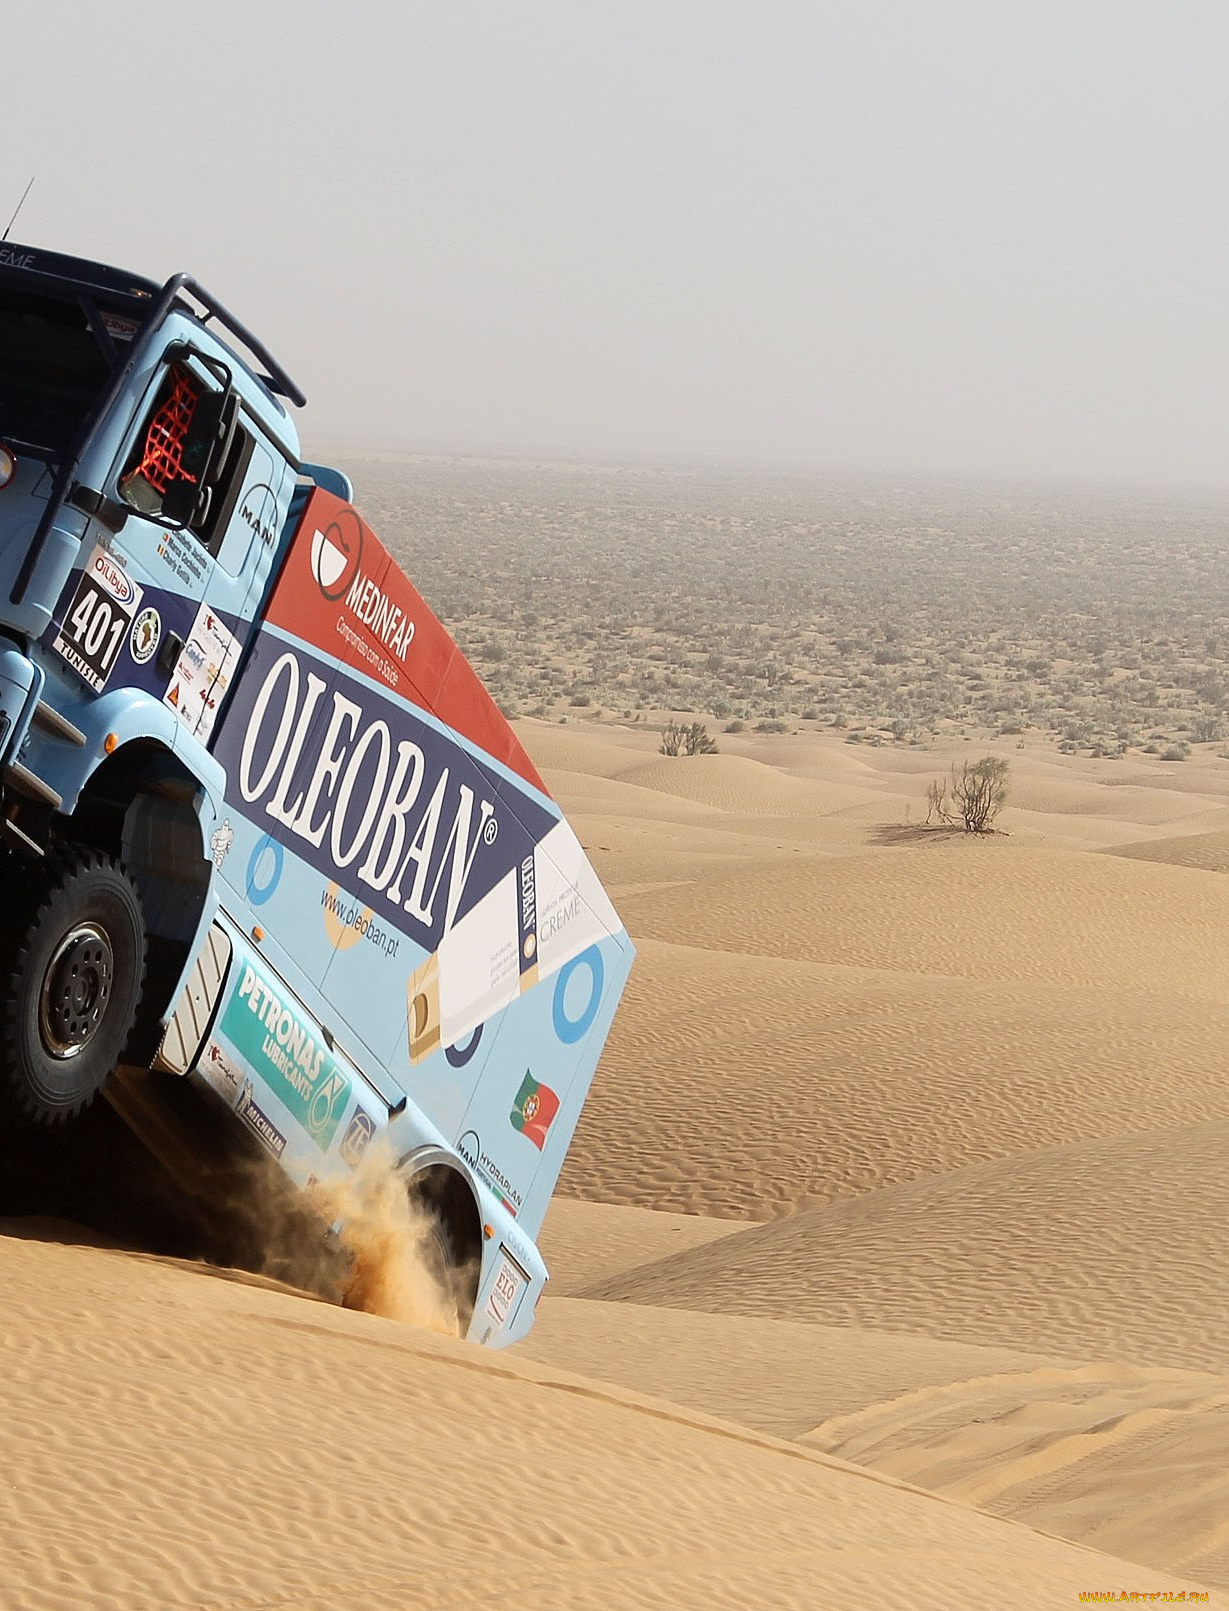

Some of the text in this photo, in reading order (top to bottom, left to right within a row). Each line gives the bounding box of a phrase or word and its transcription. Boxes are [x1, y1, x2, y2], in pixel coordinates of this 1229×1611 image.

[242, 505, 273, 546] MAN
[95, 557, 128, 598] OiLibya
[71, 589, 125, 671] 401
[345, 568, 415, 662] MEDINFAR
[60, 642, 101, 688] TUNISIE
[521, 855, 536, 930] OLEOBAN
[320, 890, 400, 957] www.oleoban.pt
[539, 897, 581, 943] CREME
[238, 965, 326, 1082] PETRONAS
[262, 1034, 314, 1102] LUBRICANTS
[246, 1105, 286, 1152] MICHELIN
[457, 1143, 476, 1171] MAN
[480, 1152, 523, 1206] HYDRAPLAN
[496, 1272, 515, 1300] ELO
